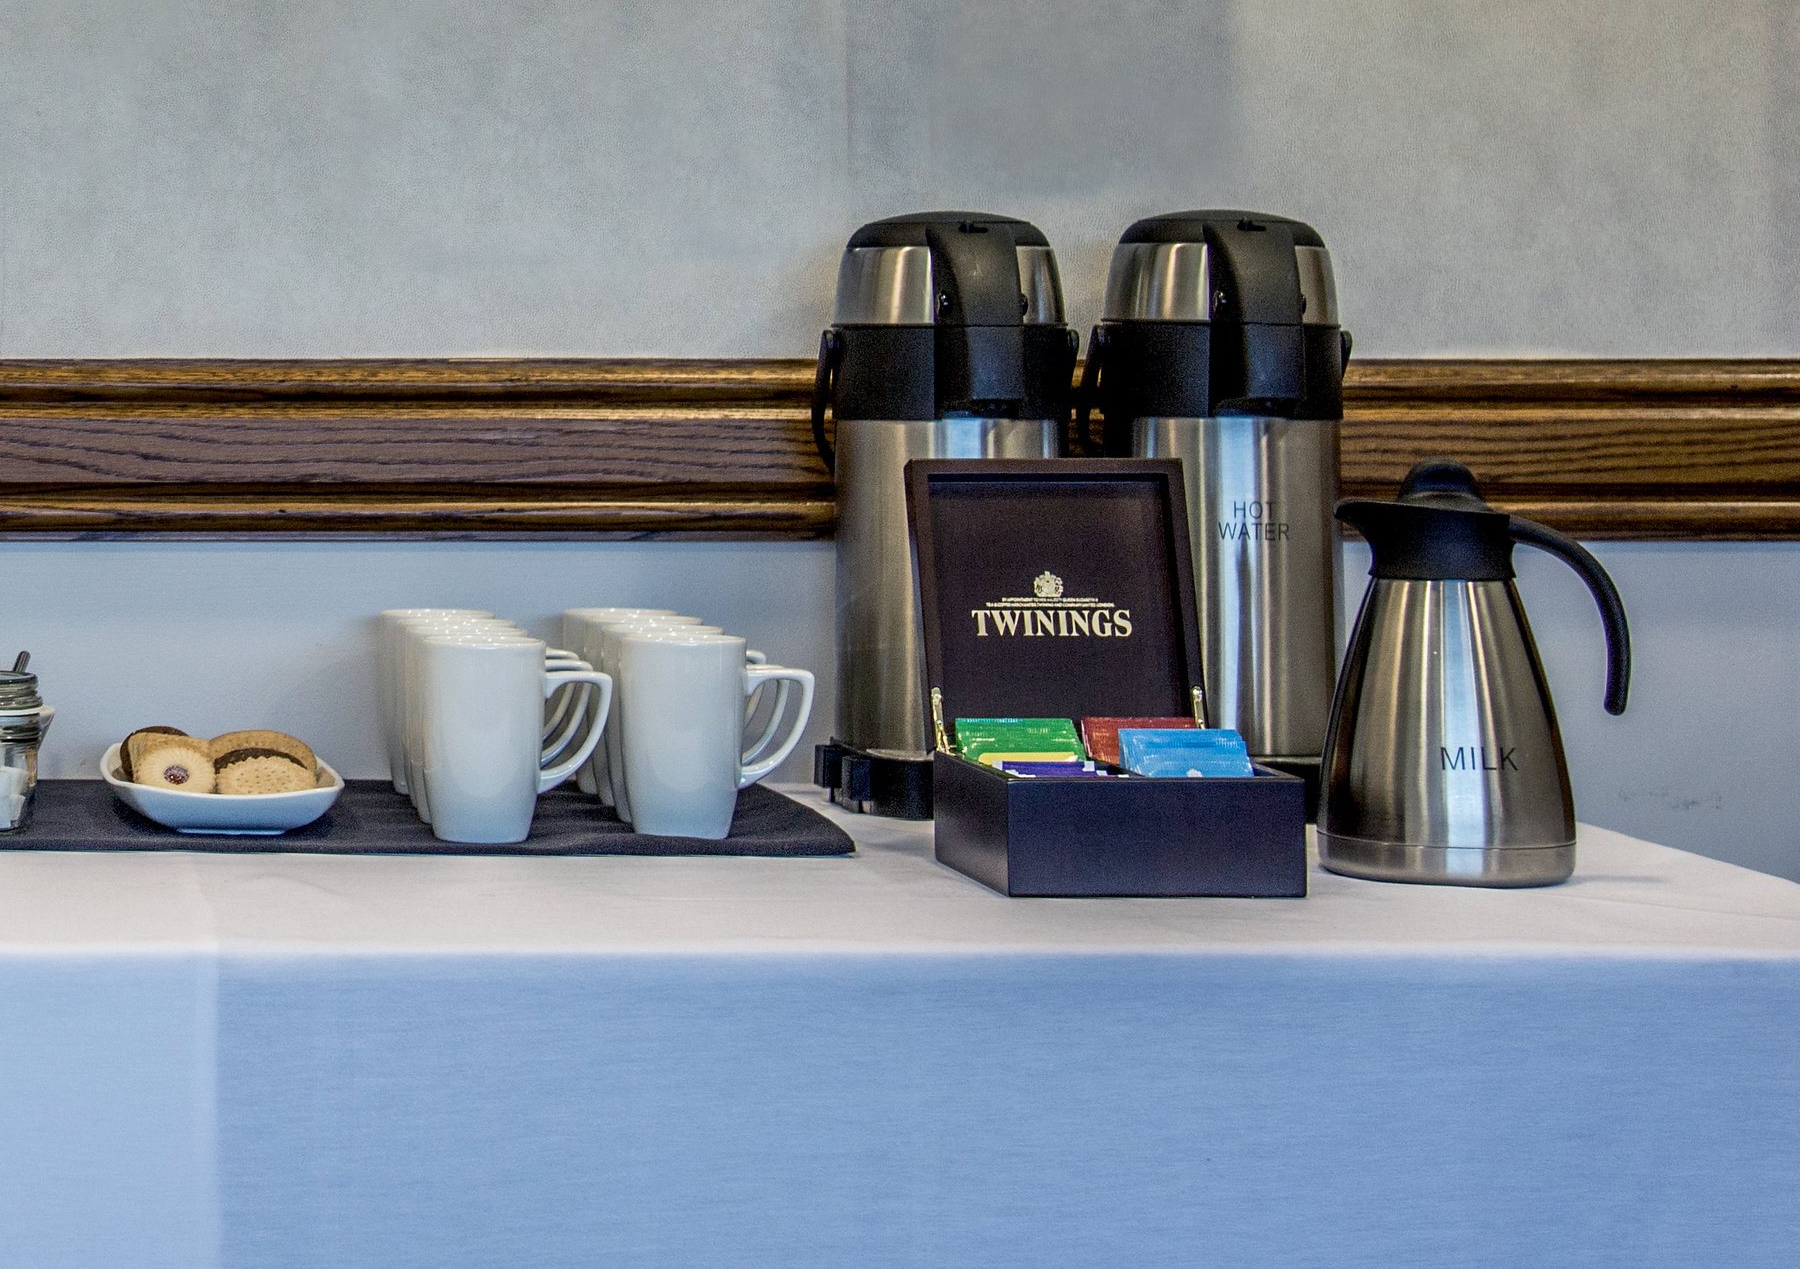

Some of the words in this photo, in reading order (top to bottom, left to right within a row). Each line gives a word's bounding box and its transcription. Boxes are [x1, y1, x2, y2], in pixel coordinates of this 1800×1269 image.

[1233, 500, 1275, 519] HOT
[1218, 522, 1291, 541] WATER
[971, 609, 1133, 638] TWININGS
[1439, 746, 1519, 772] MILK
